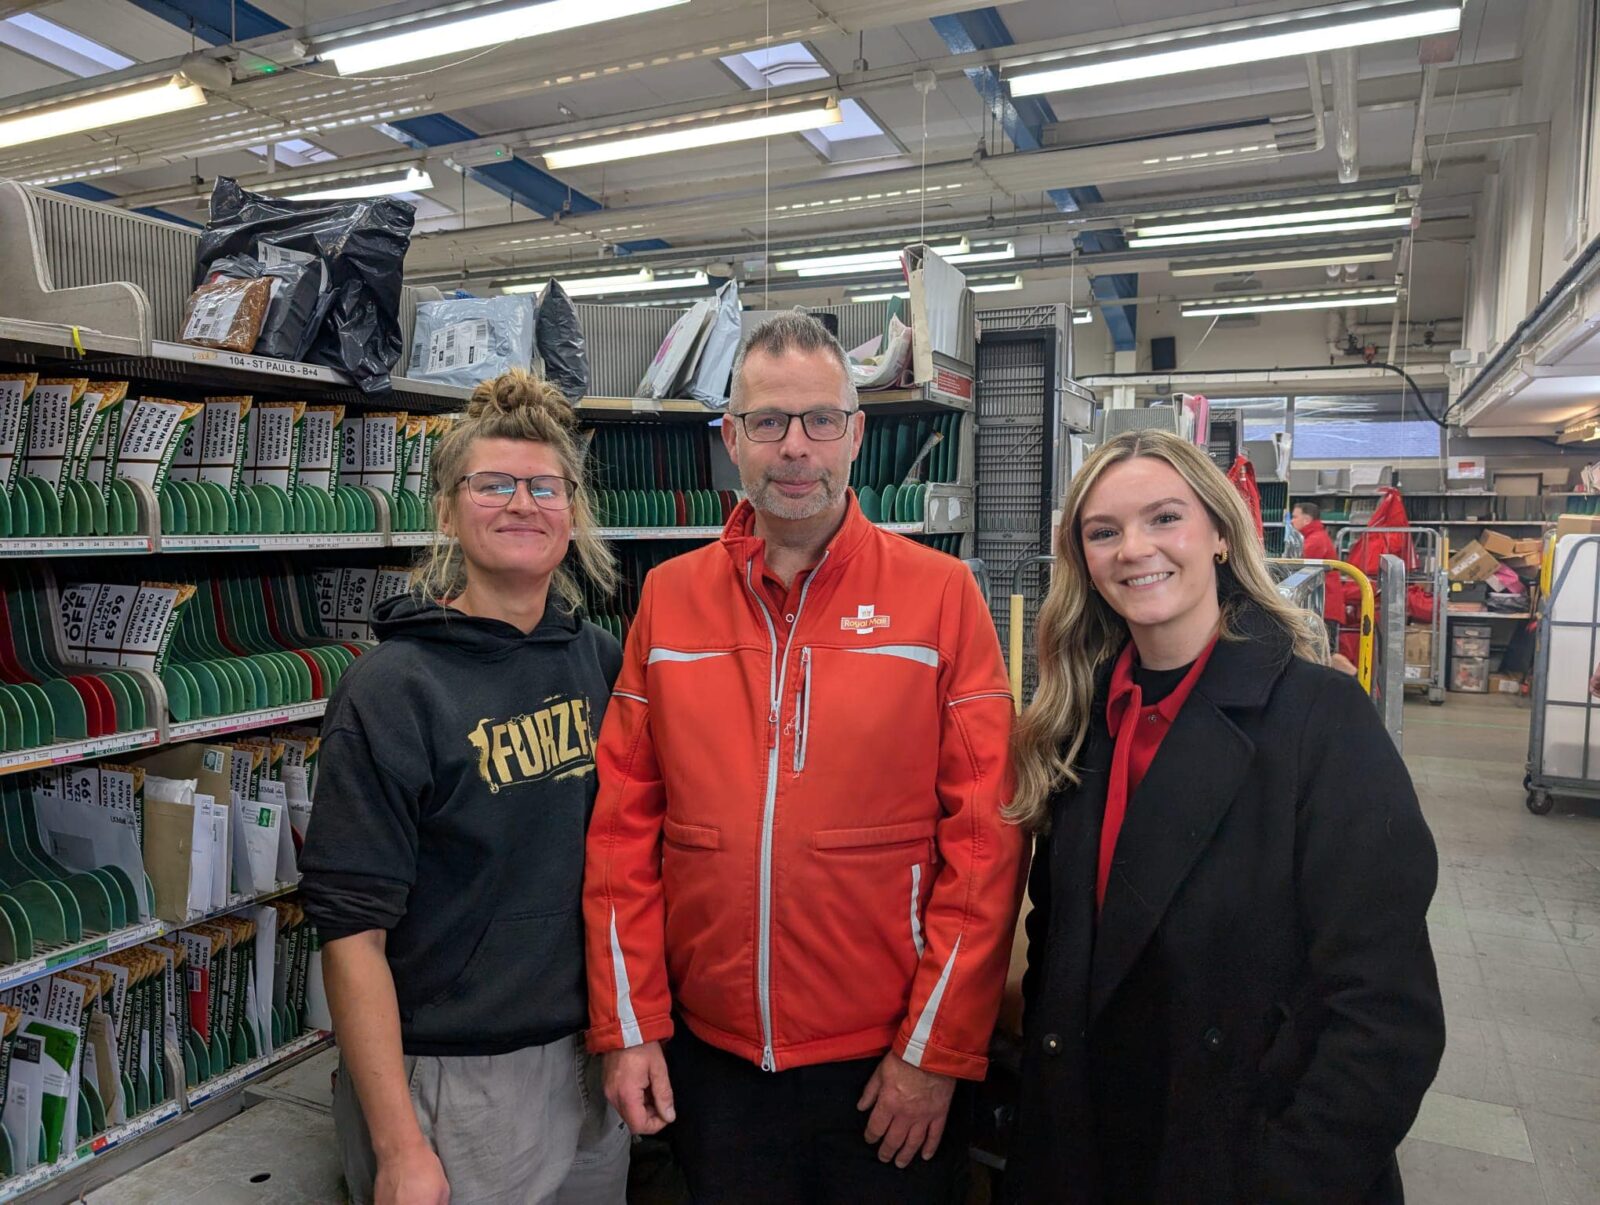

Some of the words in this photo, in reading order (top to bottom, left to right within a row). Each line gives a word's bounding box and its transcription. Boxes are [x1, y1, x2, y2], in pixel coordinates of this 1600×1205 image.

[229, 356, 245, 366] 104
[252, 359, 264, 369] ST
[266, 361, 295, 374] PAULS
[302, 367, 318, 377] B+4
[45, 391, 50, 404] TO
[51, 392, 59, 418] PAPA
[216, 408, 222, 420] TO
[8, 392, 20, 441] REWARDS
[31, 392, 42, 449] DOWNLOAD
[48, 421, 57, 448] EARN
[57, 396, 68, 444] REWARDS
[77, 402, 95, 441] EWARDS
[123, 406, 146, 453] DOWNLOAD
[133, 436, 143, 453] OUR
[139, 419, 150, 435] APP
[147, 407, 157, 418] TO
[143, 430, 157, 453] EARN
[153, 409, 168, 429] PAPA
[154, 413, 177, 450] REWARDS
[204, 409, 214, 459] DOWNLOAD
[222, 409, 230, 432] PAPA
[227, 412, 237, 454] REWARDS
[269, 413, 276, 423] TO
[310, 417, 316, 427] TO
[373, 422, 379, 433] TO
[259, 413, 267, 461] DOWNLOAD
[282, 416, 291, 457] REWARDS
[300, 417, 308, 463] DOWNLOAD
[323, 420, 331, 459] REWARDS
[346, 427, 356, 465] £9.99
[320, 577, 334, 615] OFF
[342, 569, 352, 597] LARGE
[346, 581, 357, 606] PIZZA
[353, 576, 367, 614] £9.99
[69, 595, 87, 641] OFF
[94, 586, 111, 619] LARGE
[99, 601, 113, 631] PIZZA
[104, 595, 126, 641] £9.99
[126, 592, 146, 643] DOWNLOAD
[134, 626, 143, 644] OUR
[139, 606, 149, 625] APP
[146, 592, 155, 605] TO
[143, 619, 154, 643] EARN
[150, 595, 164, 617] PAPA
[152, 598, 172, 641] REWARDS
[90, 622, 99, 645] ANY
[844, 619, 868, 628] Royal
[868, 617, 887, 626] Mail
[81, 777, 92, 804] .99
[111, 777, 116, 790] TO
[15, 986, 23, 1007] LAR
[28, 983, 42, 1015] .99
[48, 984, 59, 1020] NLOAD
[60, 986, 67, 1000] TO
[65, 990, 74, 1017] PAPA
